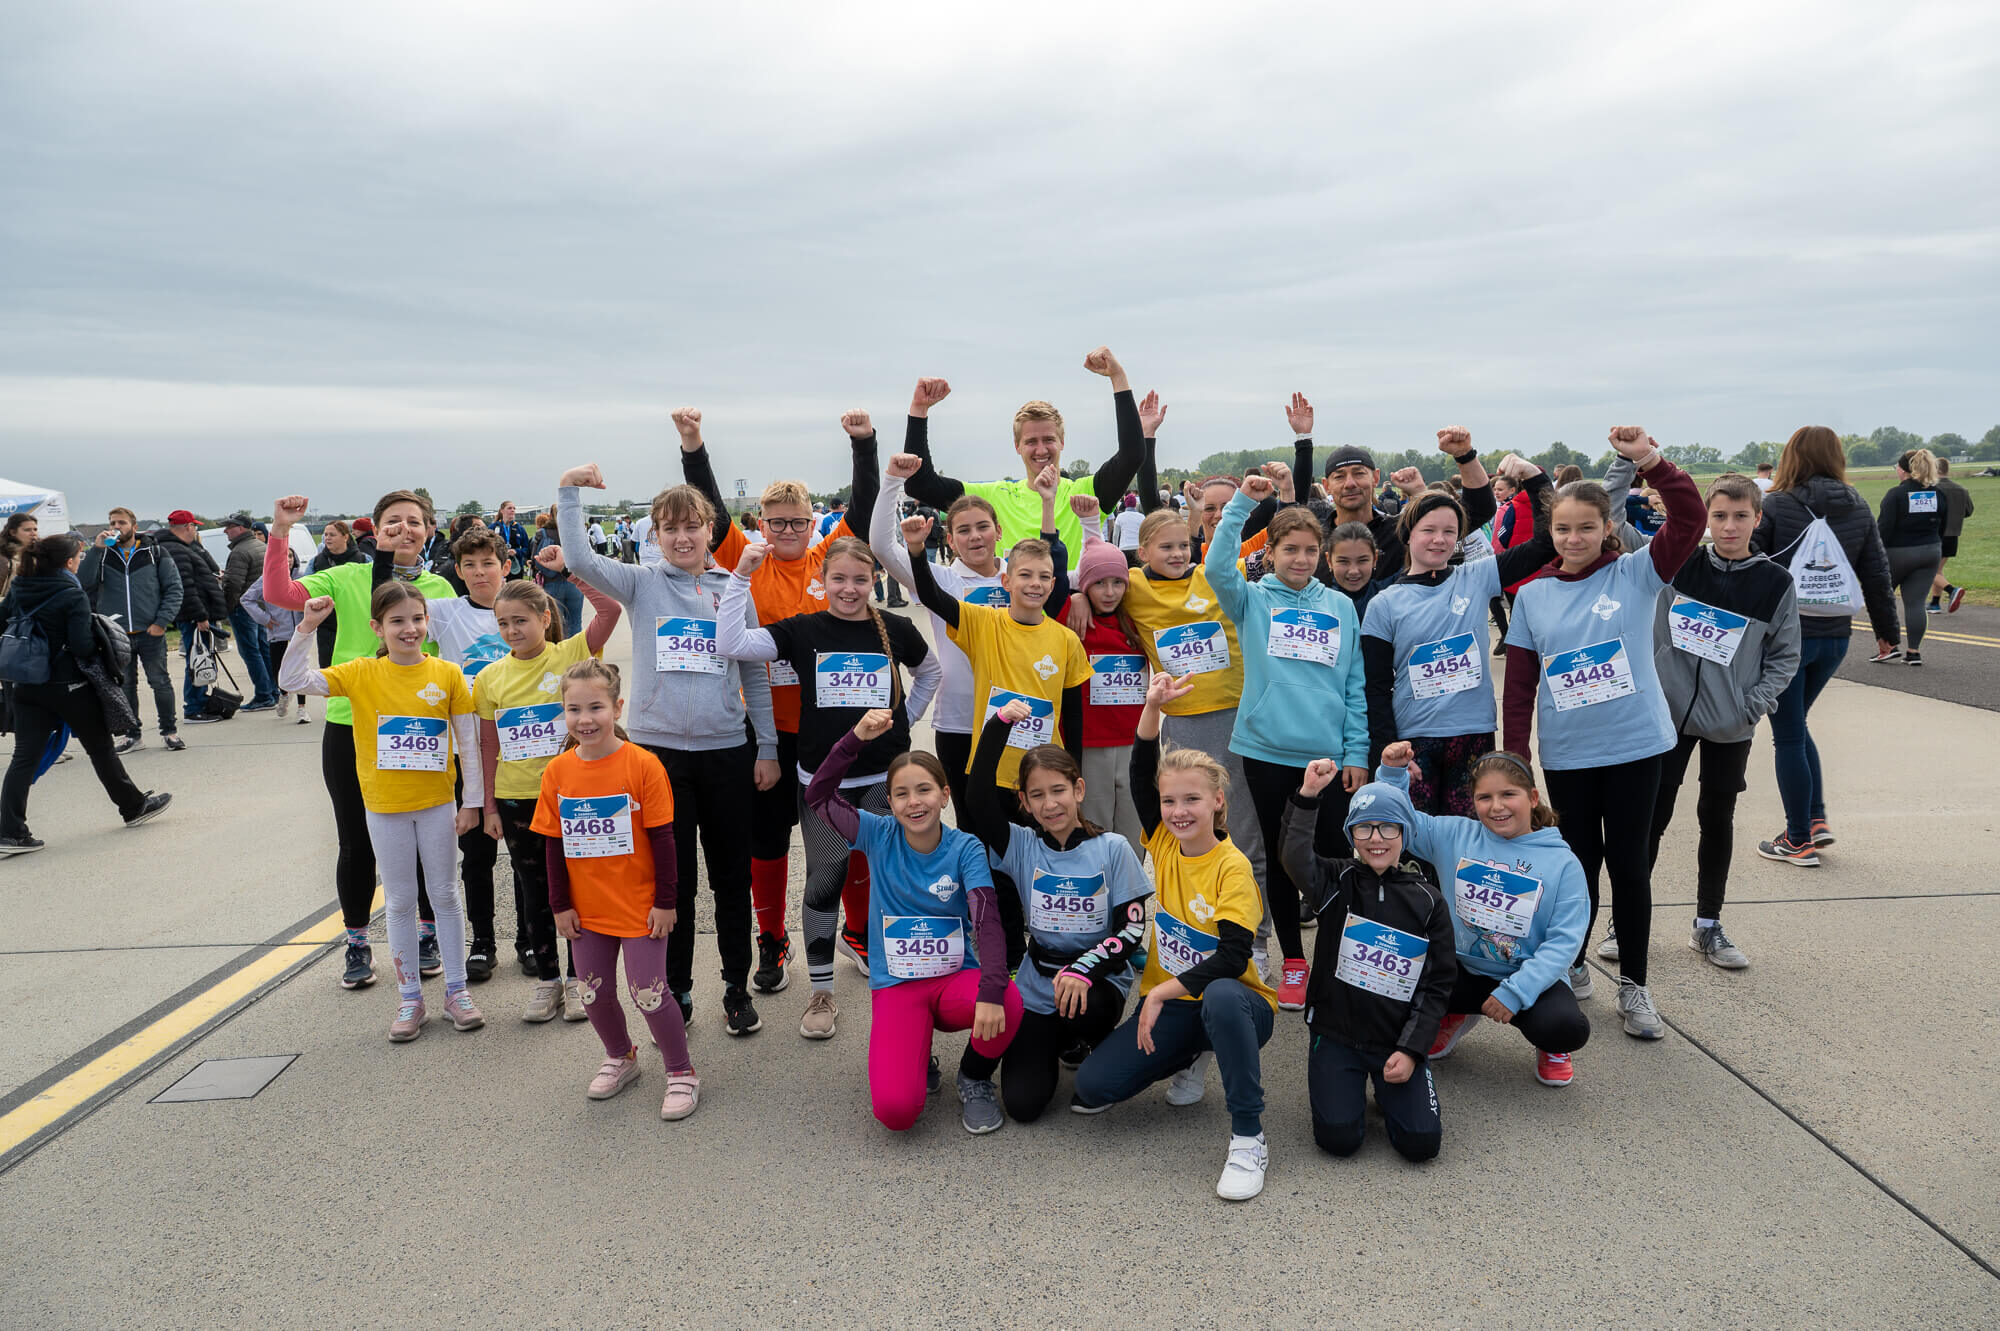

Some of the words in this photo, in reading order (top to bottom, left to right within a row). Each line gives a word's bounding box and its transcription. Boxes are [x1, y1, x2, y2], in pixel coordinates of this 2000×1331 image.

[1283, 624, 1329, 645] 3458
[1677, 616, 1729, 642] 3467
[668, 636, 717, 653] 3466
[1169, 638, 1214, 659] 3461
[1420, 653, 1471, 678] 3454
[1560, 662, 1615, 688] 3448
[829, 672, 878, 687] 3470
[1102, 673, 1142, 686] 3462
[508, 722, 556, 741] 3464
[1013, 716, 1044, 732] 59
[390, 735, 439, 751] 3469
[563, 818, 616, 836] 3468
[1041, 894, 1095, 912] 3456
[1464, 883, 1519, 911] 3457
[895, 938, 949, 956] 3450
[1159, 930, 1204, 966] 3460
[1352, 943, 1412, 977] 3463
